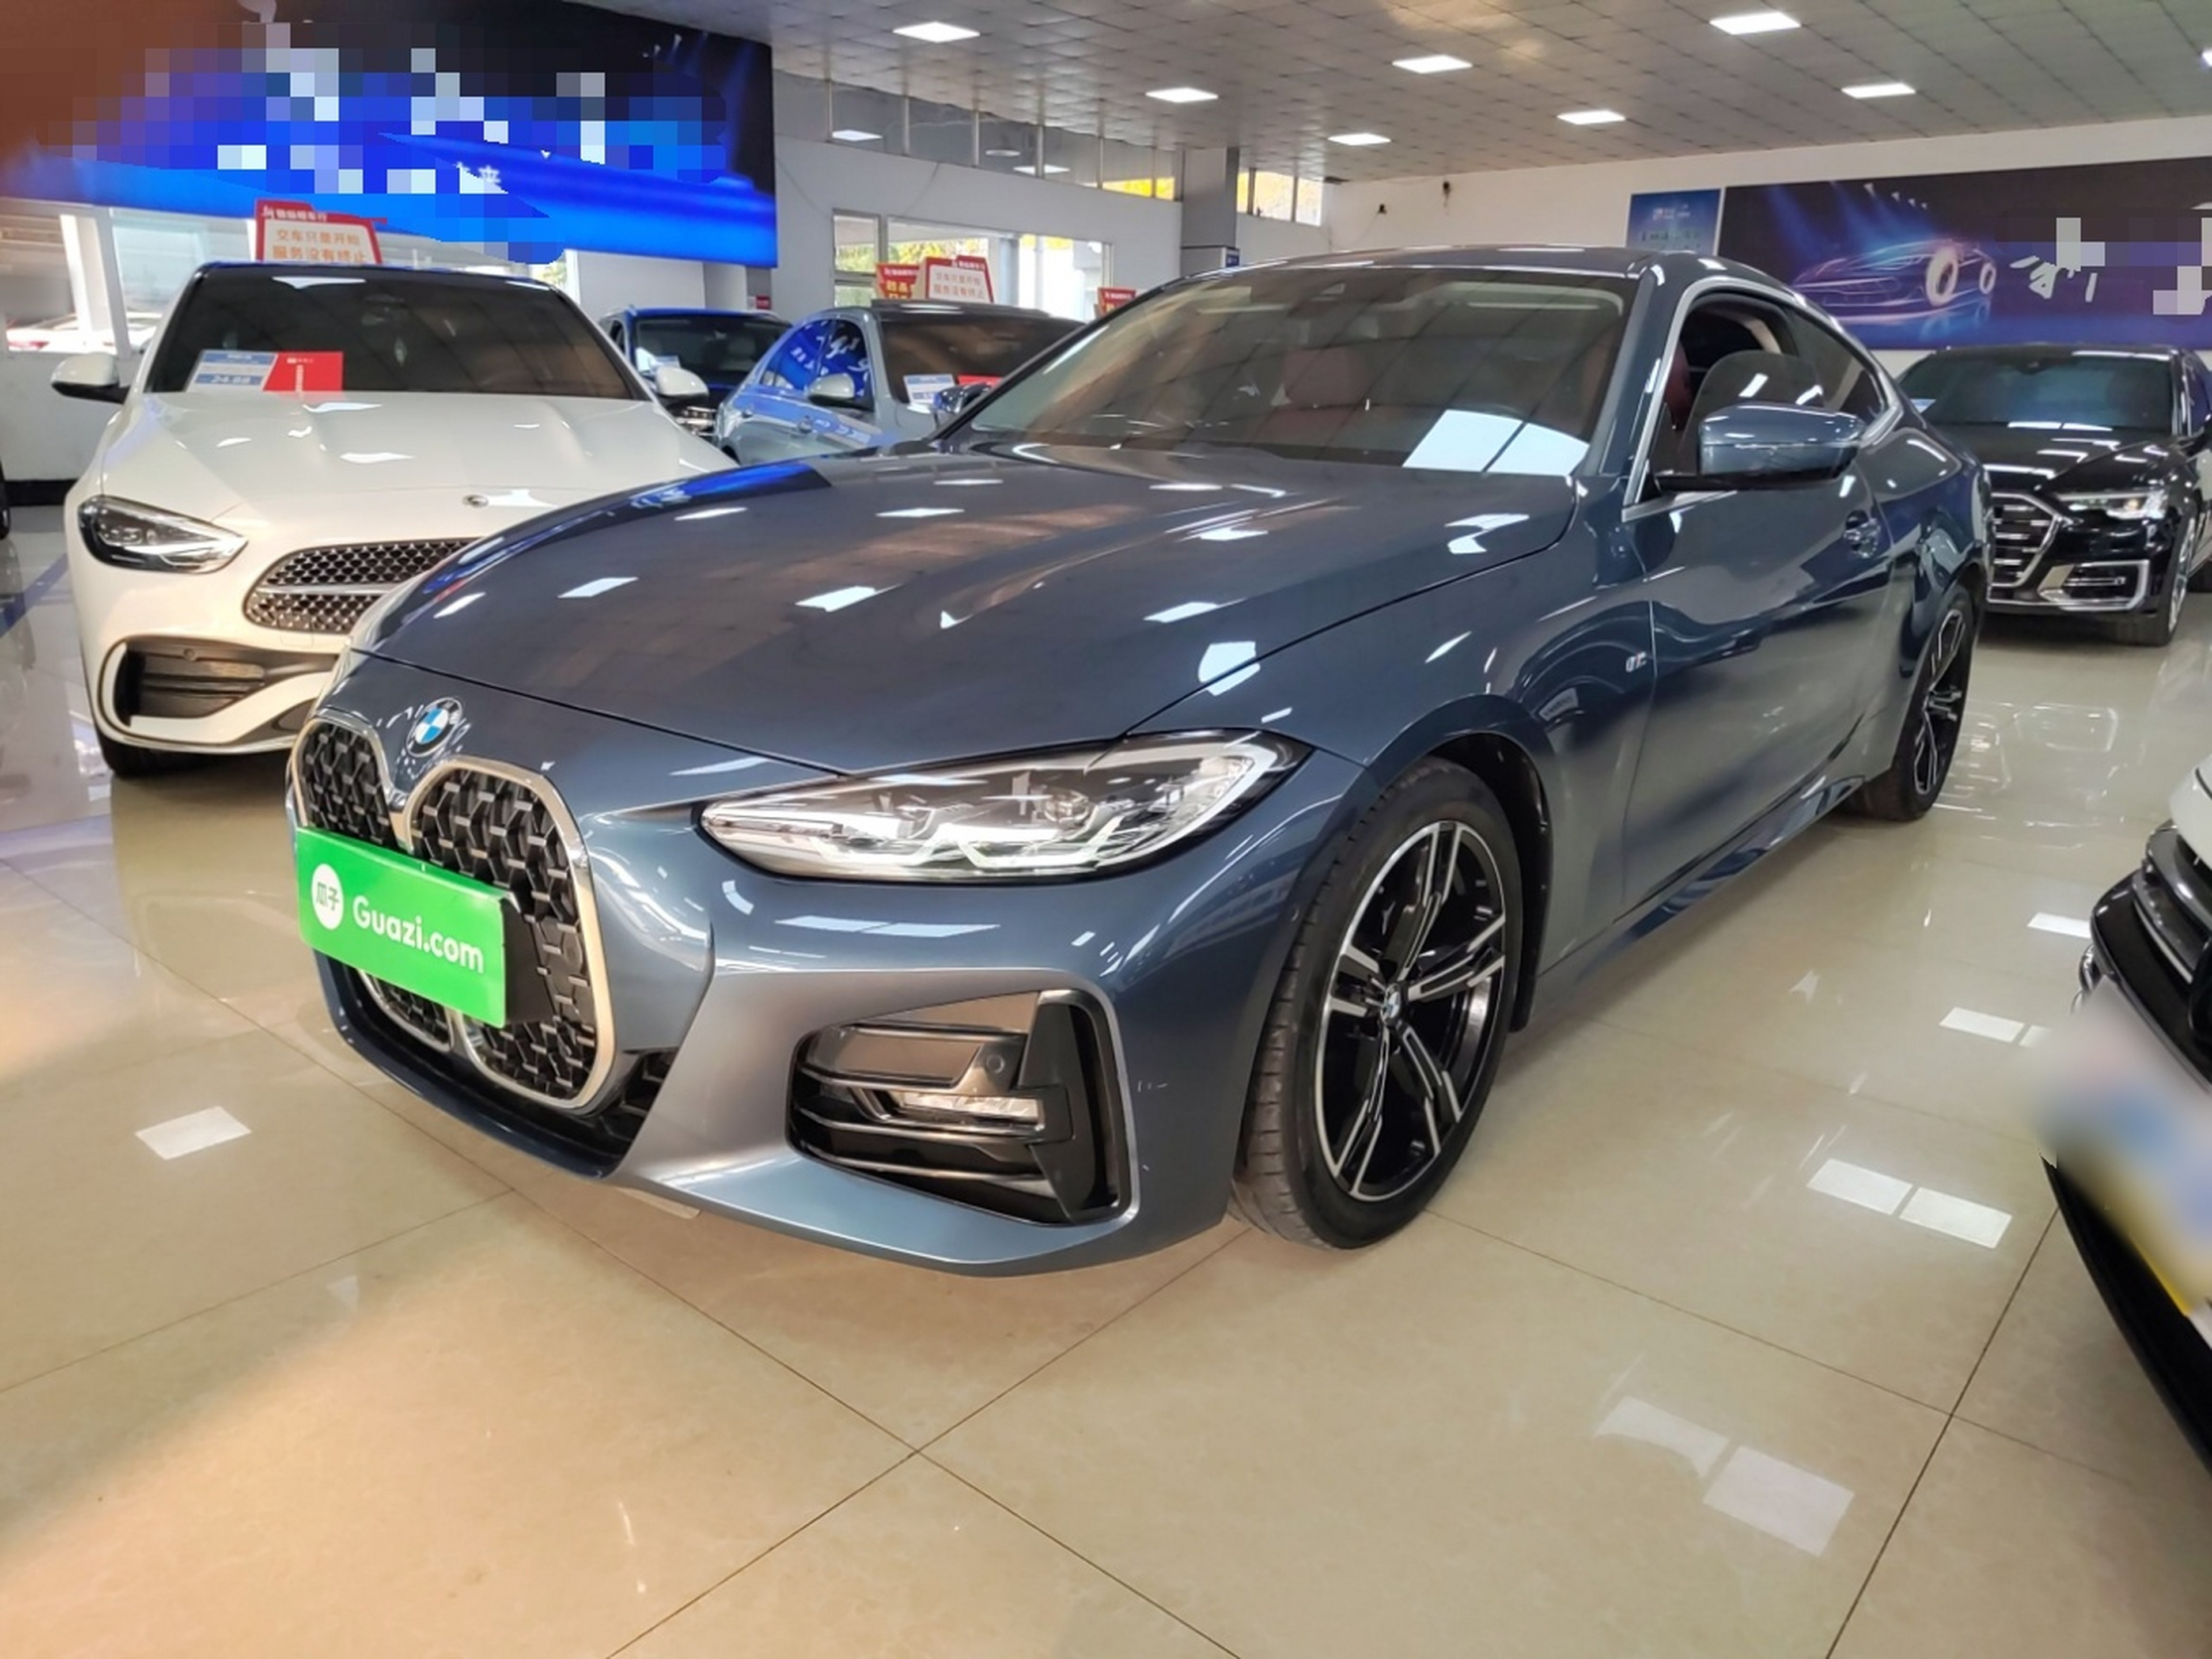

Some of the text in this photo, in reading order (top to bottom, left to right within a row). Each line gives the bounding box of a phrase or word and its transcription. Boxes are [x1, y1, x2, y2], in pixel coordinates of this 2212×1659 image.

[277, 229, 360, 245] 交车只是开始
[272, 246, 365, 263] 服务没有终止
[316, 881, 339, 911] 瓜子
[352, 895, 484, 974] Guazi.com
